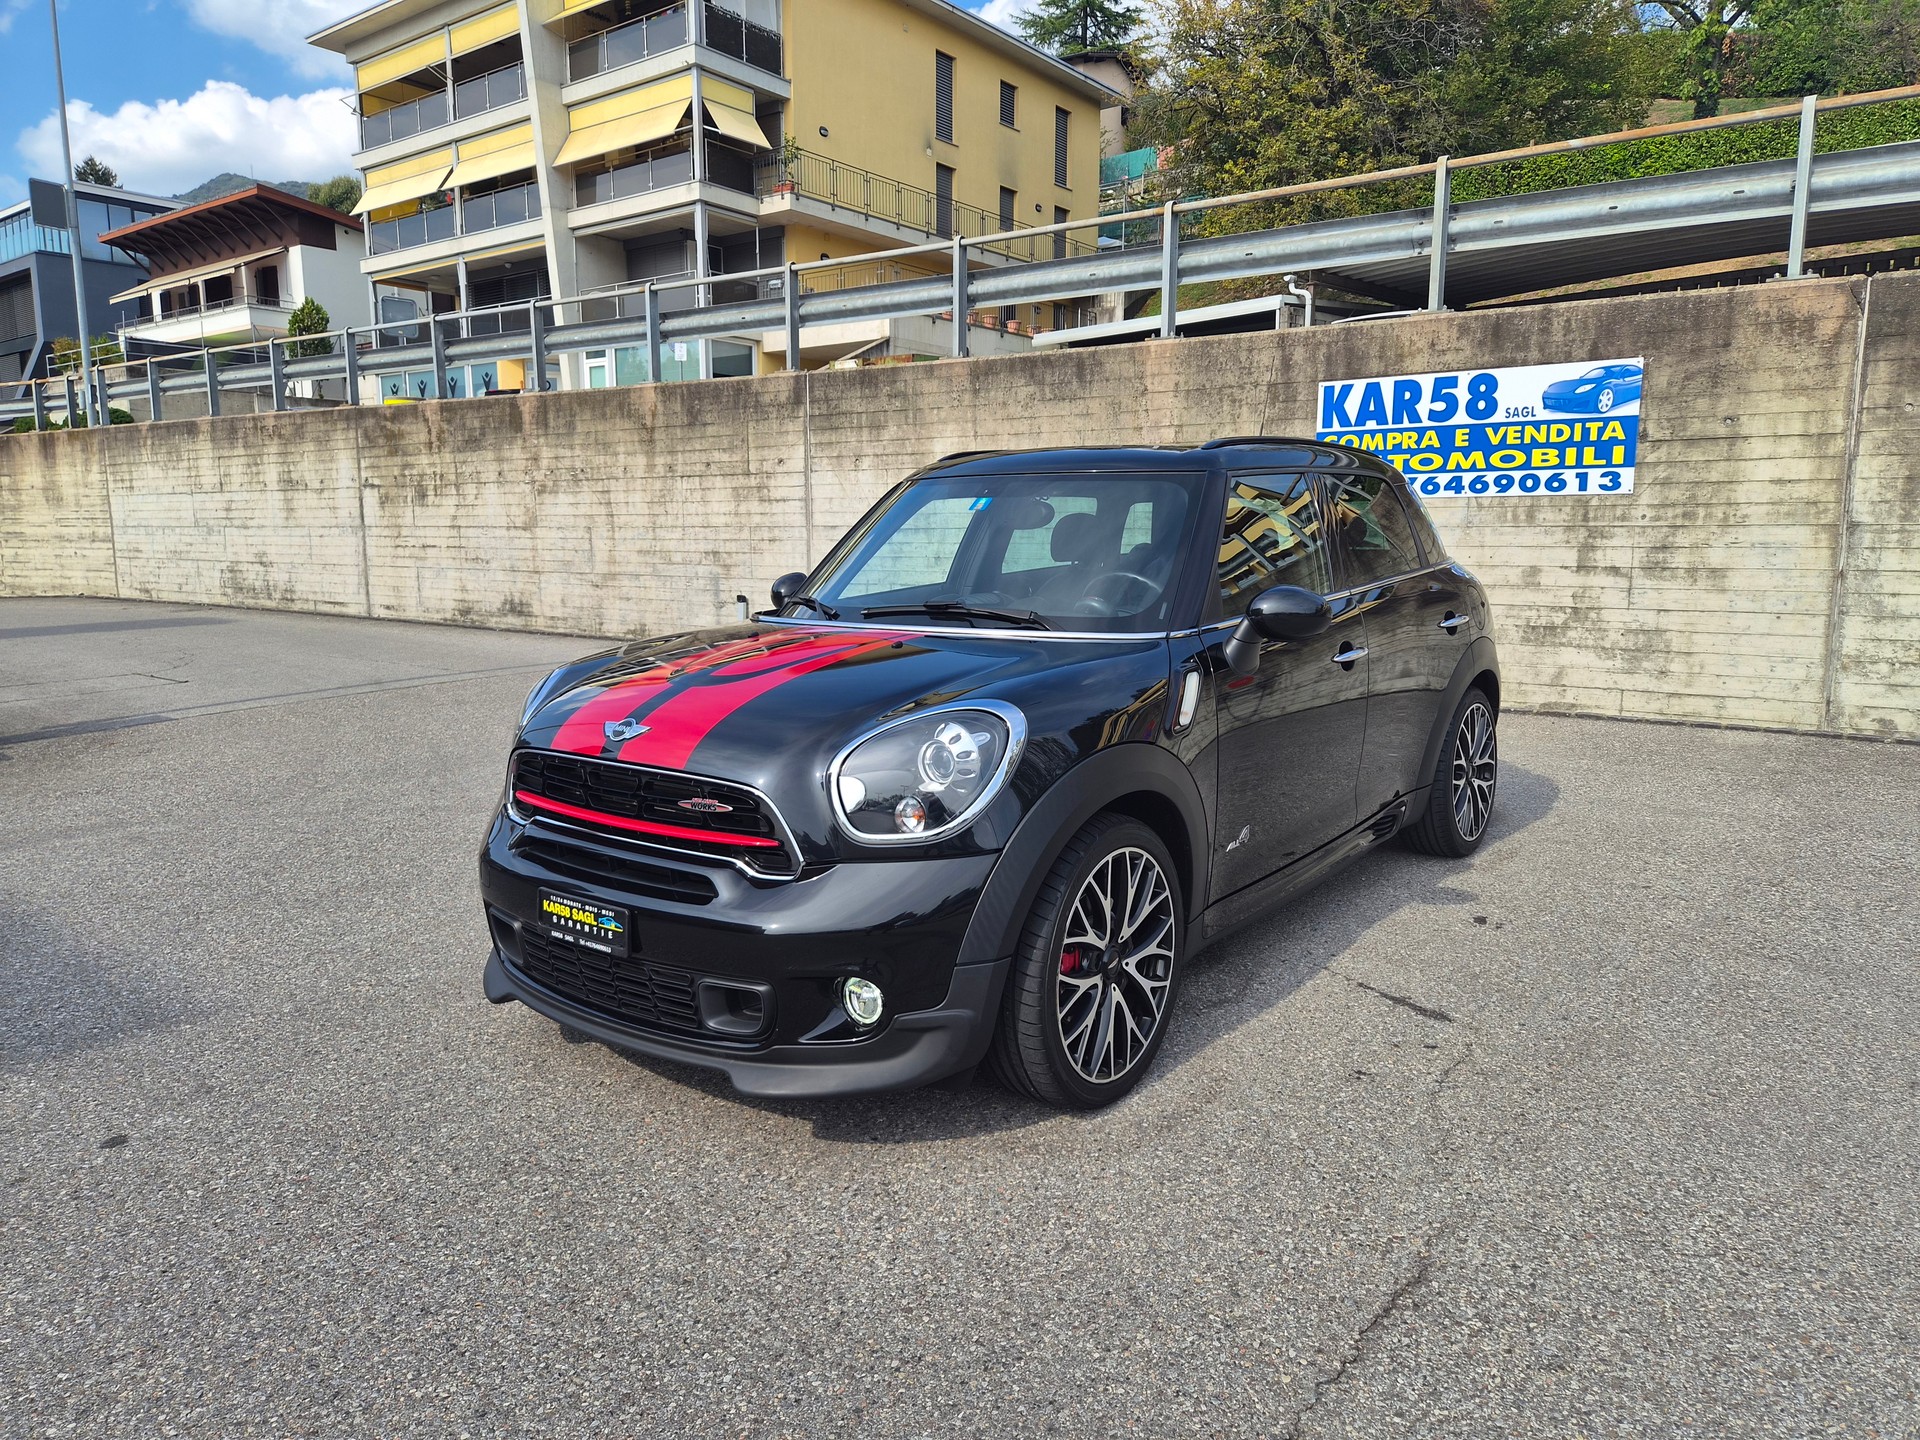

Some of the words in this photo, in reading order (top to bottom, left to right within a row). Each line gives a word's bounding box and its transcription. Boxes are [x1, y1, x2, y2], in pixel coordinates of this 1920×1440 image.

[1321, 372, 1499, 429] KAR58
[1504, 406, 1537, 419] SAGL
[1455, 428, 1470, 447] E
[1487, 420, 1626, 446] VENDITA
[1379, 445, 1625, 472] TOMOBILI
[1407, 470, 1622, 496] 64690613
[691, 801, 717, 811] WORKS
[543, 899, 570, 918] KAR58
[572, 908, 597, 926] SAGL
[552, 915, 613, 939] GARANTIE
